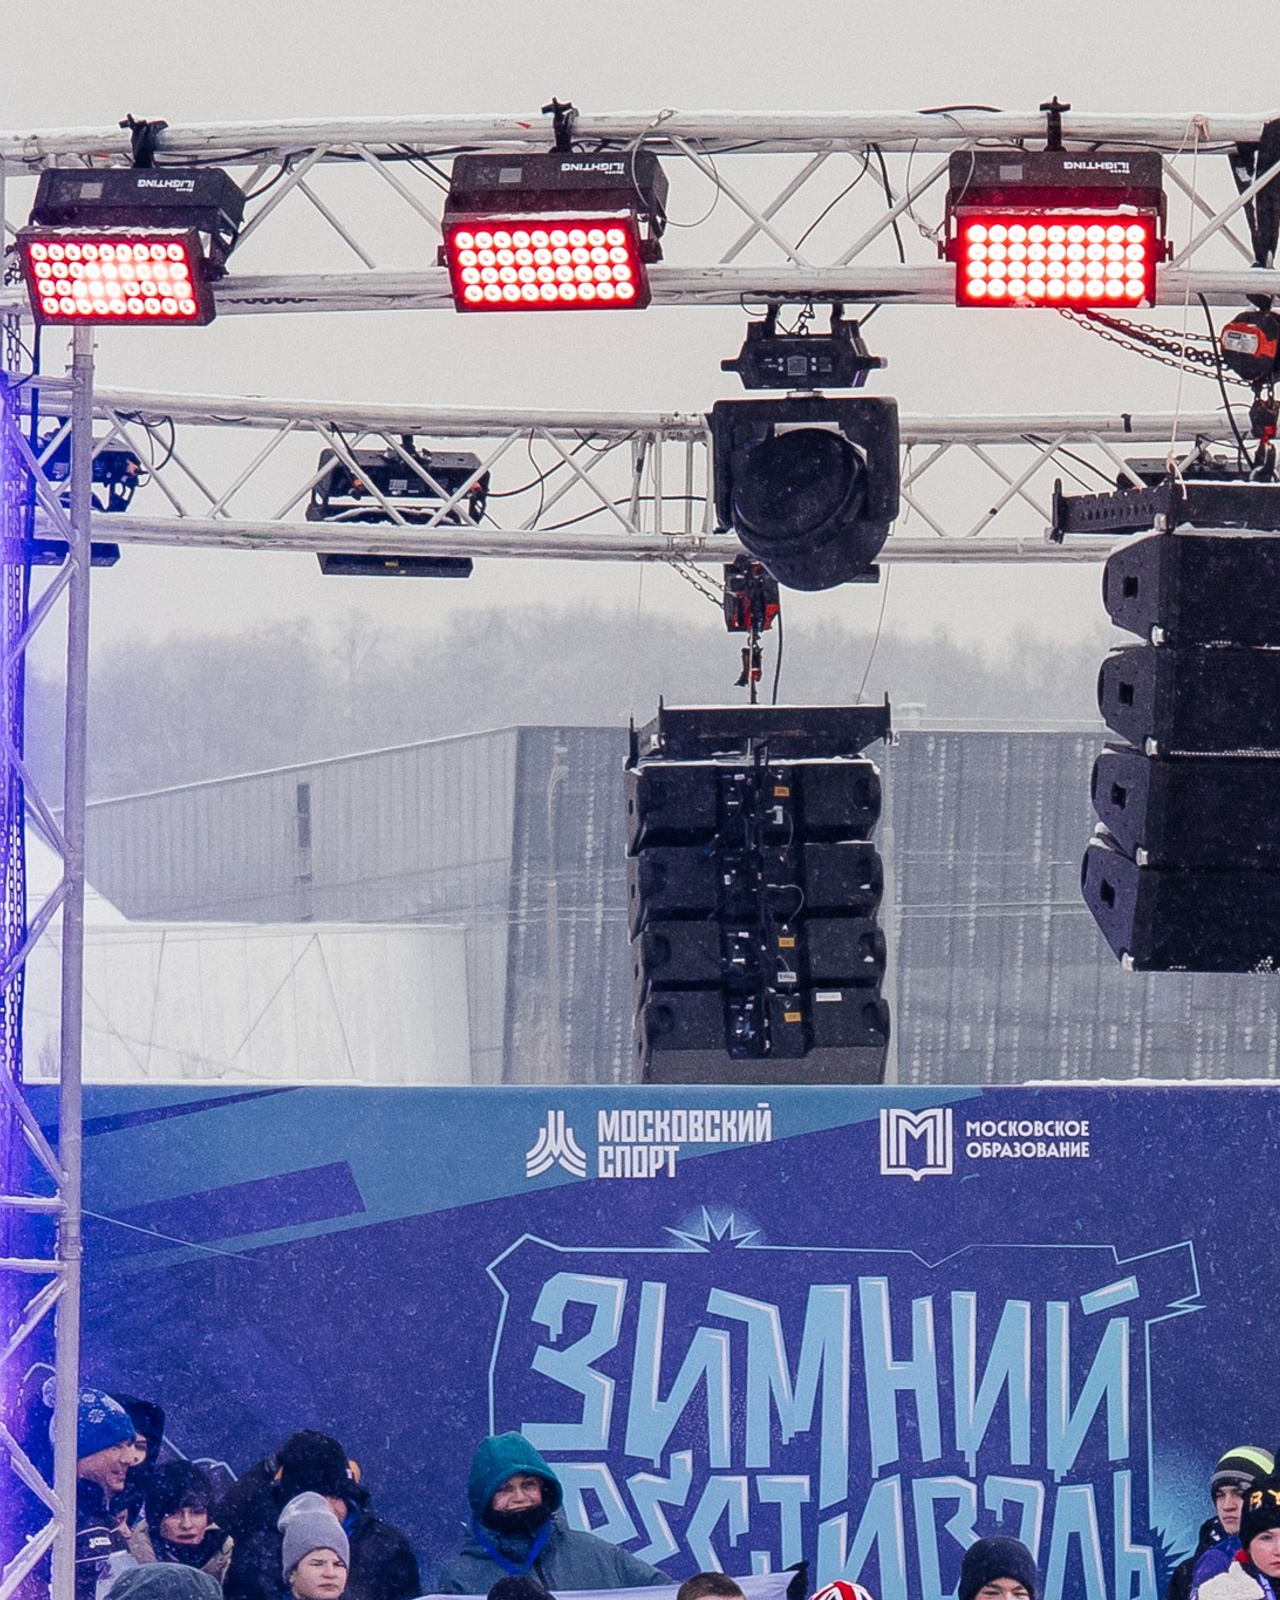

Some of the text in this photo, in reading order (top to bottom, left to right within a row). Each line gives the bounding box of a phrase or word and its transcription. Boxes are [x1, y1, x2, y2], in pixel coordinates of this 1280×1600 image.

[598, 1103, 771, 1142] МОСКОВСКИЙ
[966, 1120, 1089, 1137] МОСКОВСКОЕ
[598, 1145, 677, 1178] СПОРТ
[966, 1141, 1089, 1158] ОБРАЗОВАНИЕ
[520, 1271, 1140, 1512] ЗИМНИЙ
